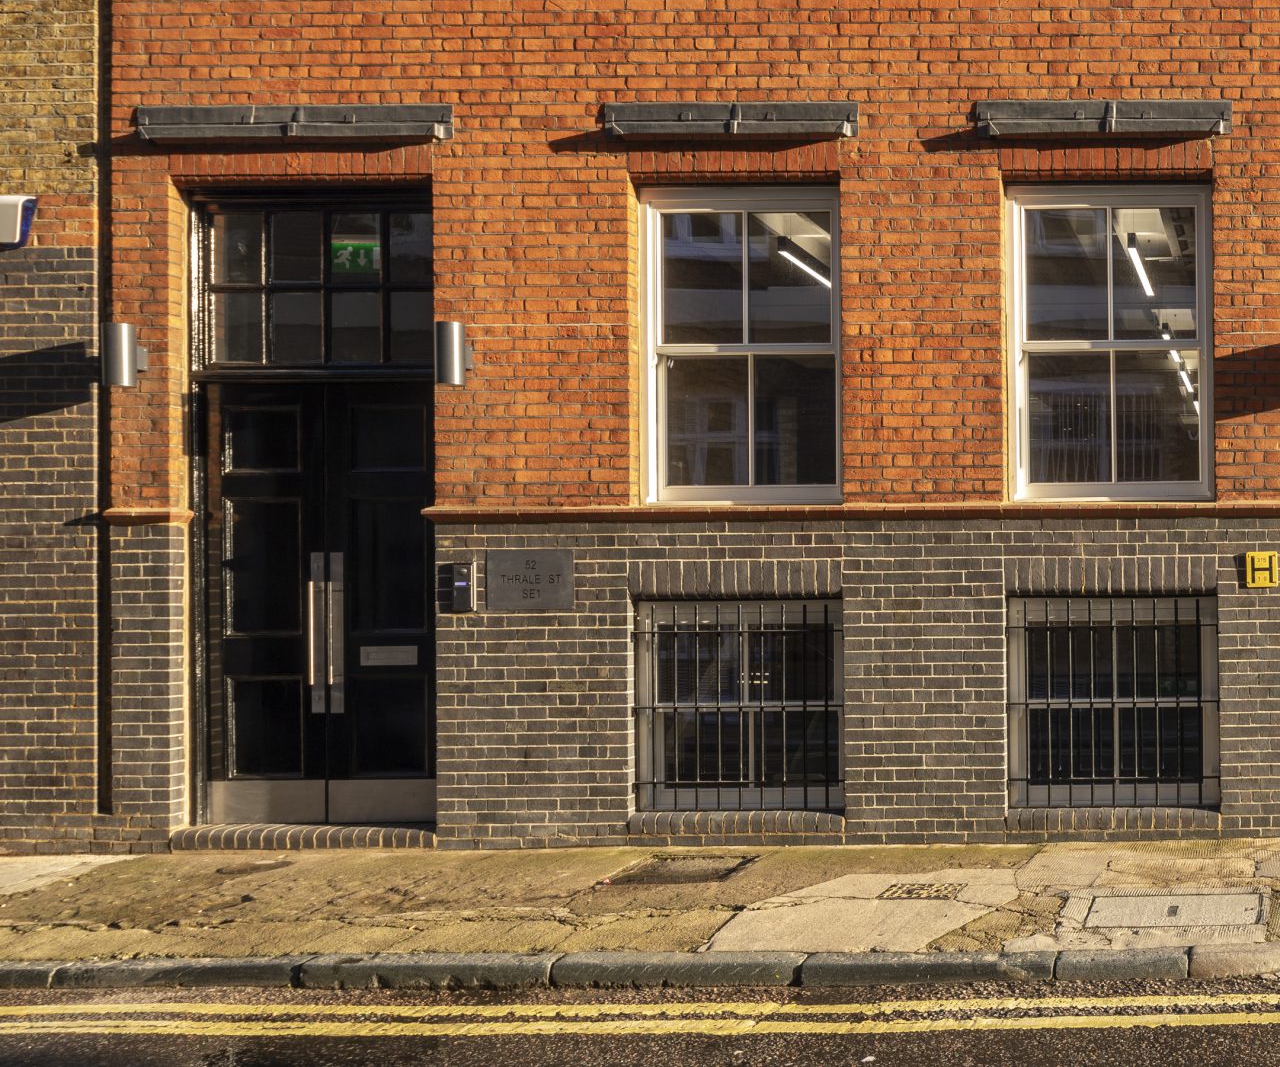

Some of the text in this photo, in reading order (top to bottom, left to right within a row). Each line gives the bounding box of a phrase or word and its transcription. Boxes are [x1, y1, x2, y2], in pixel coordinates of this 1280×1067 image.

[525, 559, 537, 570] 52
[1251, 555, 1274, 583] H
[500, 574, 562, 585] THRALE ST
[522, 588, 541, 599] SE1
